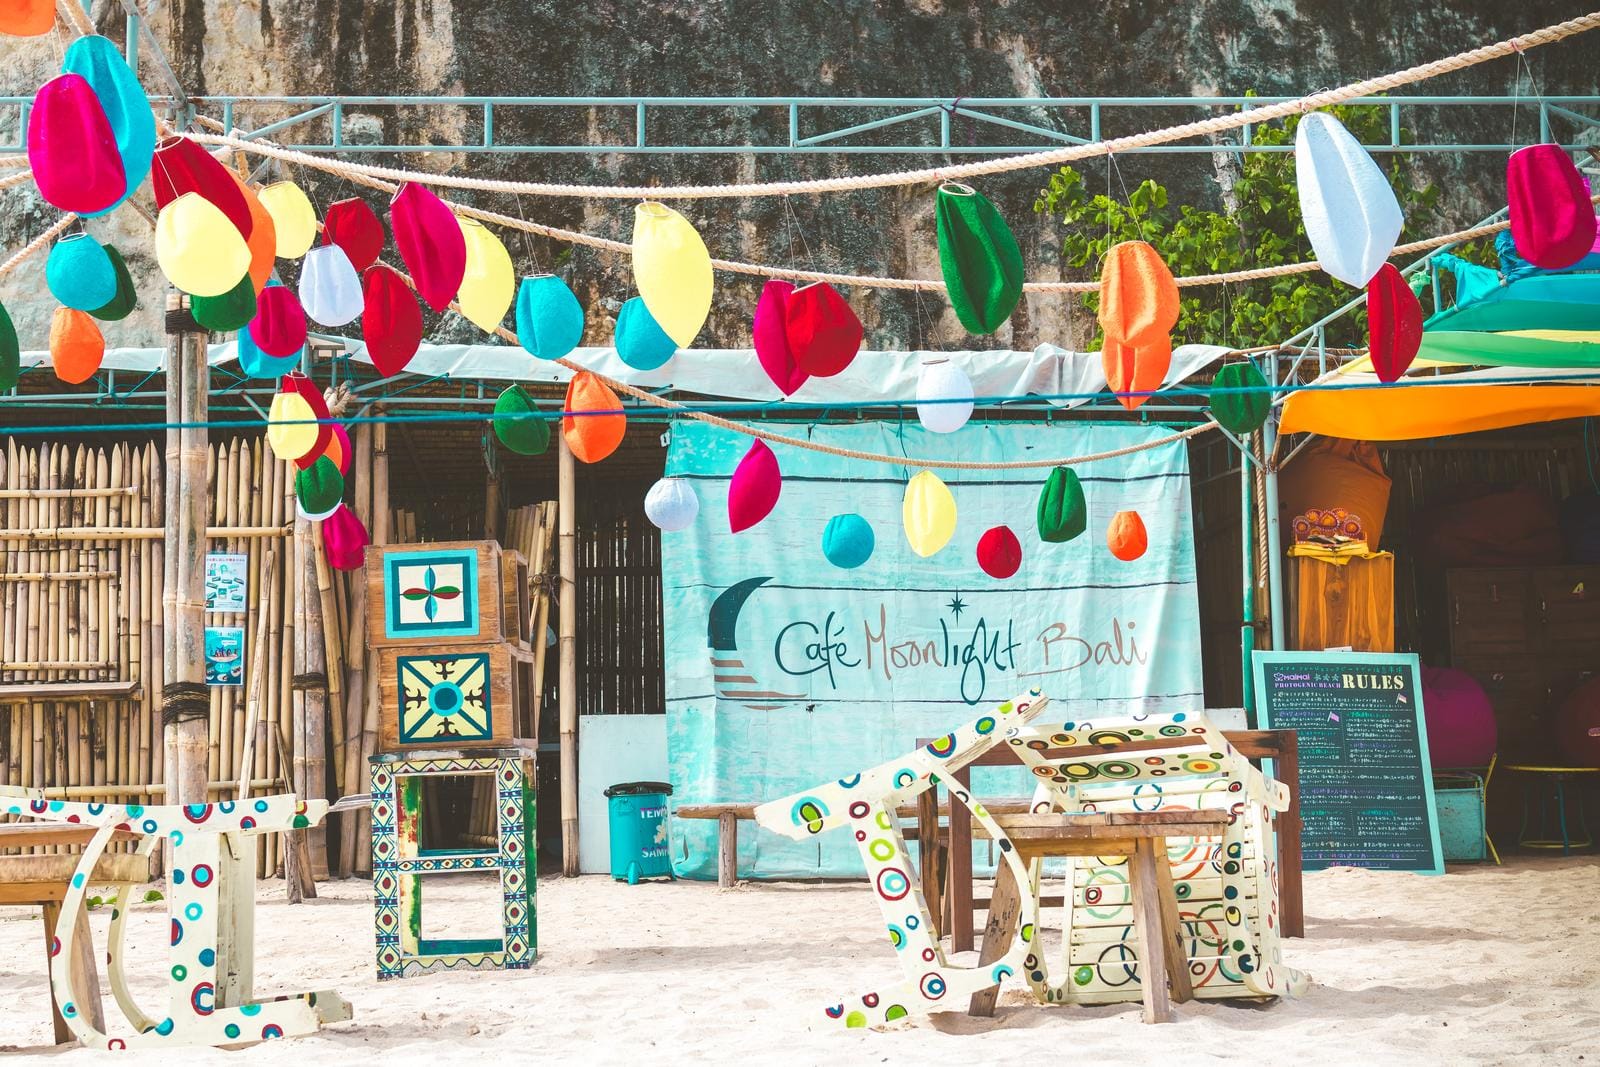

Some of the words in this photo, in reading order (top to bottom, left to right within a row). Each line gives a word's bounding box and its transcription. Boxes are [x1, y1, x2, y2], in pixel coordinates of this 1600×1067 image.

[775, 611, 862, 690] Café
[1017, 617, 1148, 678] Bali
[1342, 674, 1404, 690] RULES
